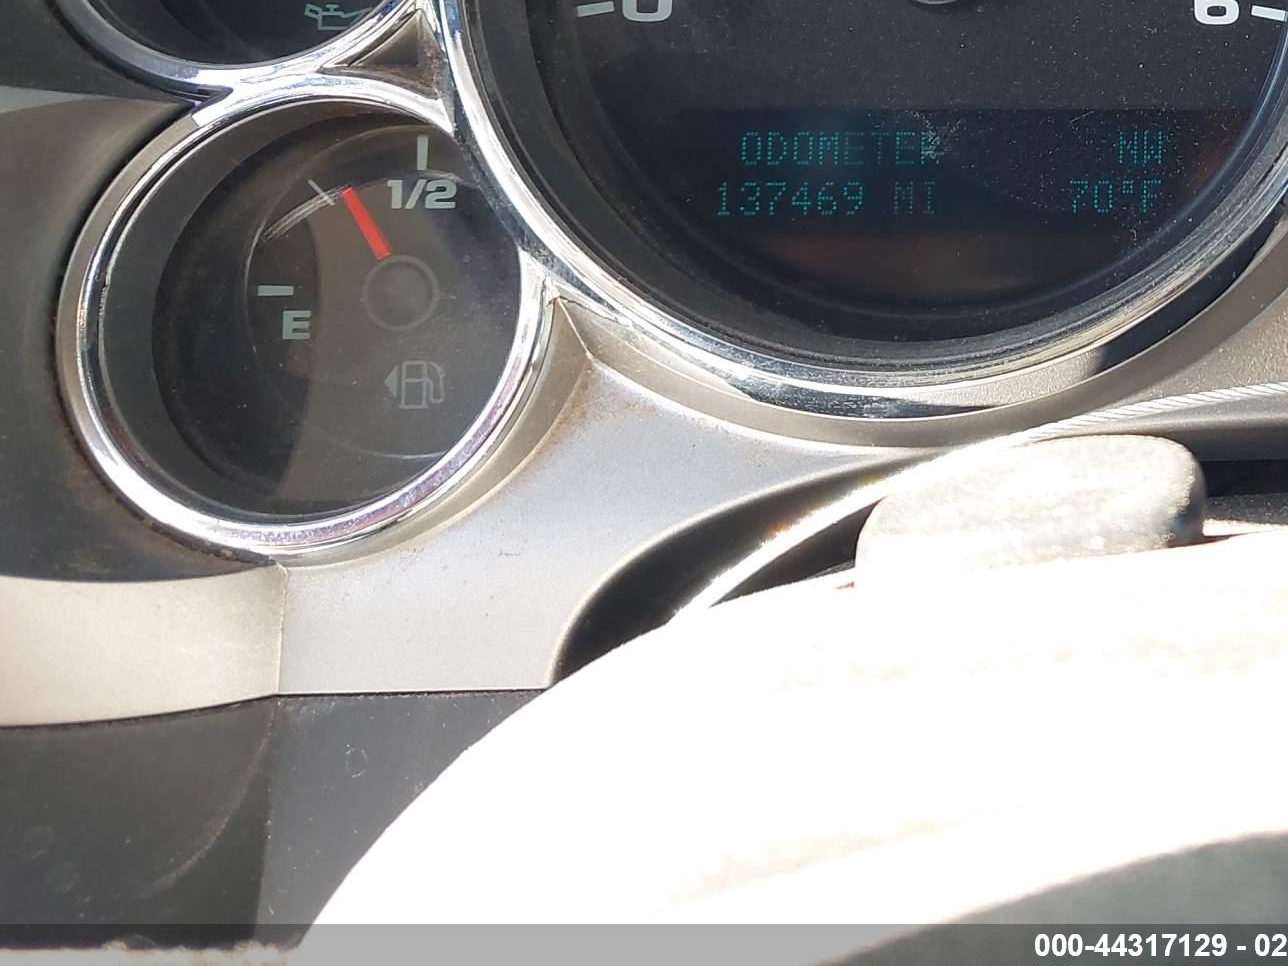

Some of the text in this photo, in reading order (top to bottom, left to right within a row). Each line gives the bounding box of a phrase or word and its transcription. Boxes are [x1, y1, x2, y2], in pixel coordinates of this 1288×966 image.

[739, 131, 940, 166] ODOMETER
[387, 179, 457, 210] 1/2
[716, 182, 865, 217] 137469
[282, 310, 311, 340] E
